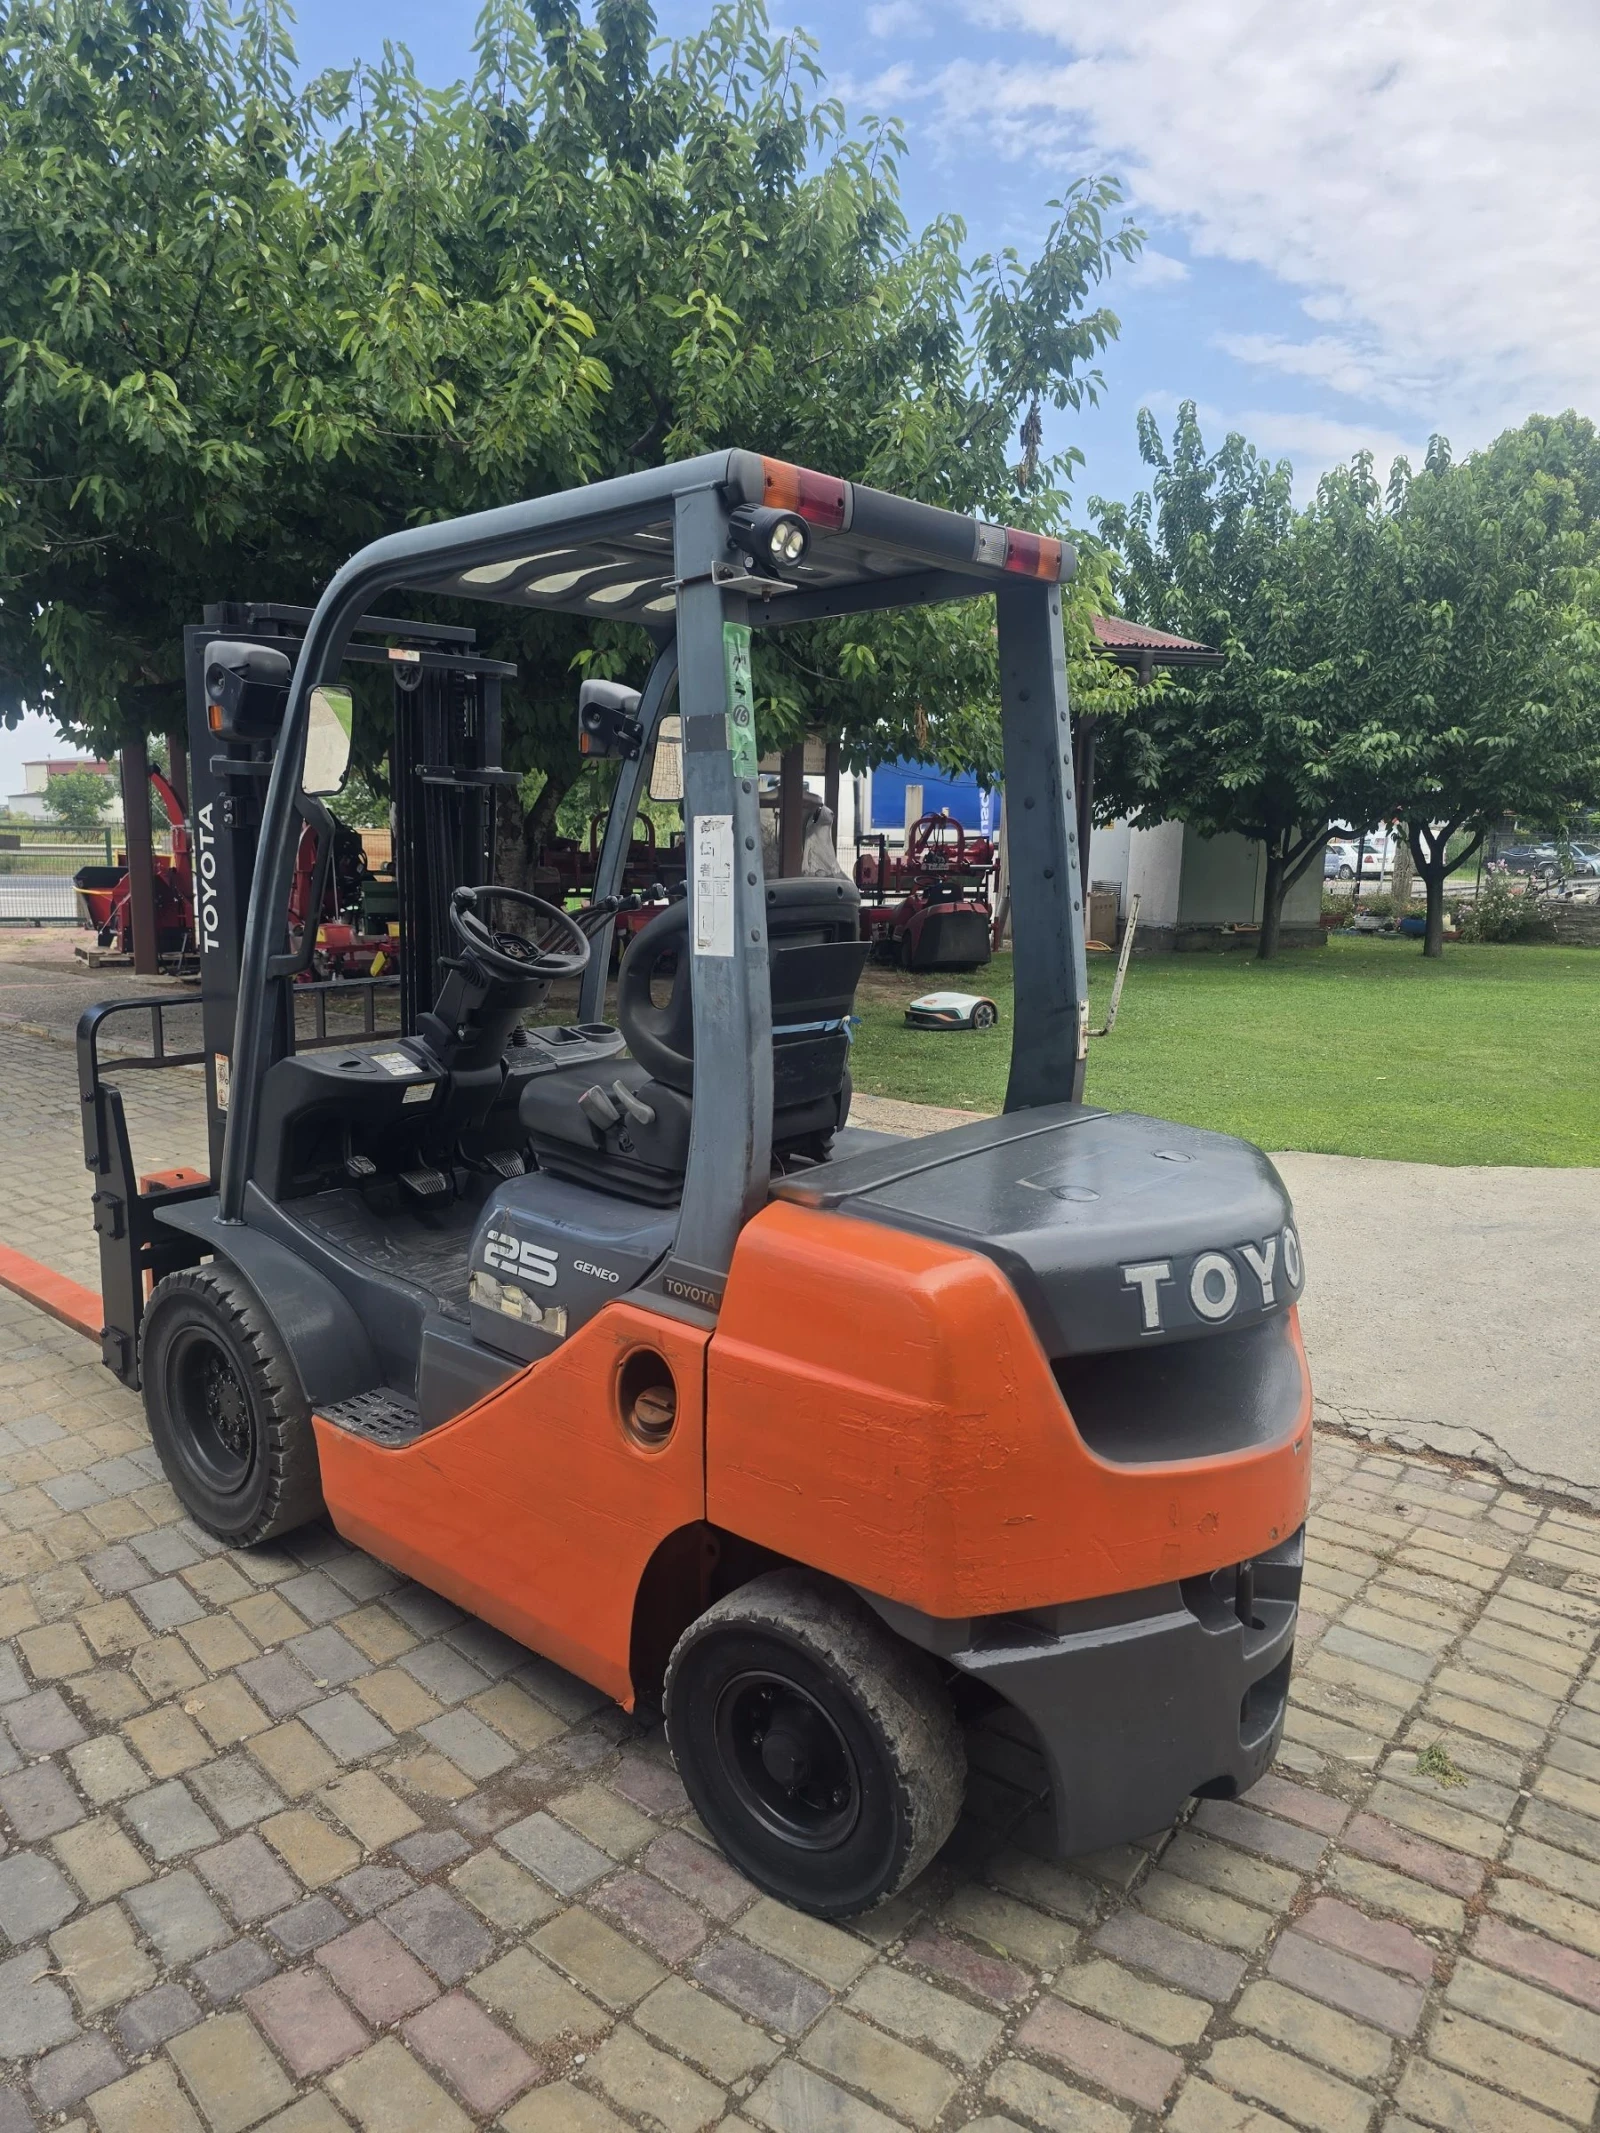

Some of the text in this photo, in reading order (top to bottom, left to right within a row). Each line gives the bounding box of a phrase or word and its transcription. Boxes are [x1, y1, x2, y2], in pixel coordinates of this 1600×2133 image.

[199, 803, 220, 953] TOYOTA
[483, 1229, 620, 1287] 25 GENEO
[666, 1278, 716, 1308] TOYOTA
[1123, 1225, 1300, 1329] TOYO
